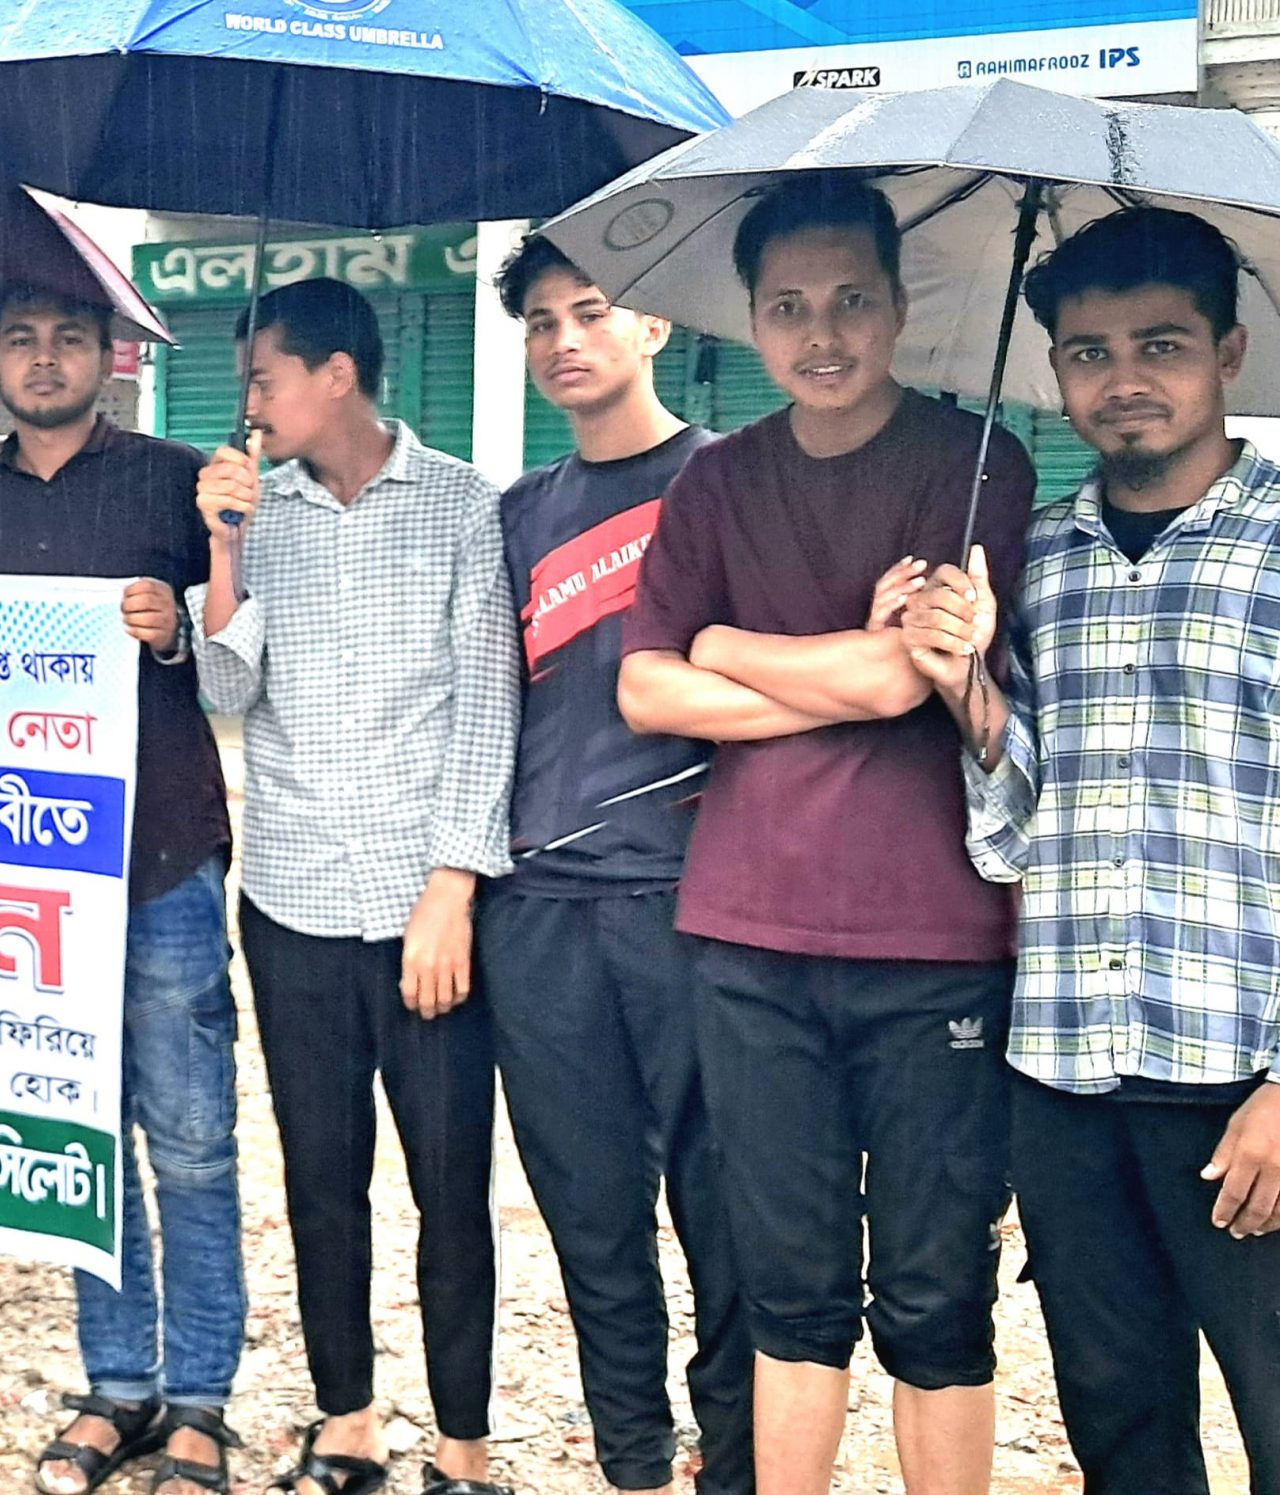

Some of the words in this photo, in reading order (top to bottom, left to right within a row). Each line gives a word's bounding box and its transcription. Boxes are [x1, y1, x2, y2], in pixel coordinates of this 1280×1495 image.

[225, 12, 287, 34] WORLD
[289, 20, 346, 41] CLASS
[349, 26, 444, 50] UMBRELLA
[976, 54, 1090, 77] RAHIMAFROOZ
[1099, 47, 1140, 69] IPS
[21, 651, 96, 685] থাকায়
[8, 711, 98, 755] নেতা
